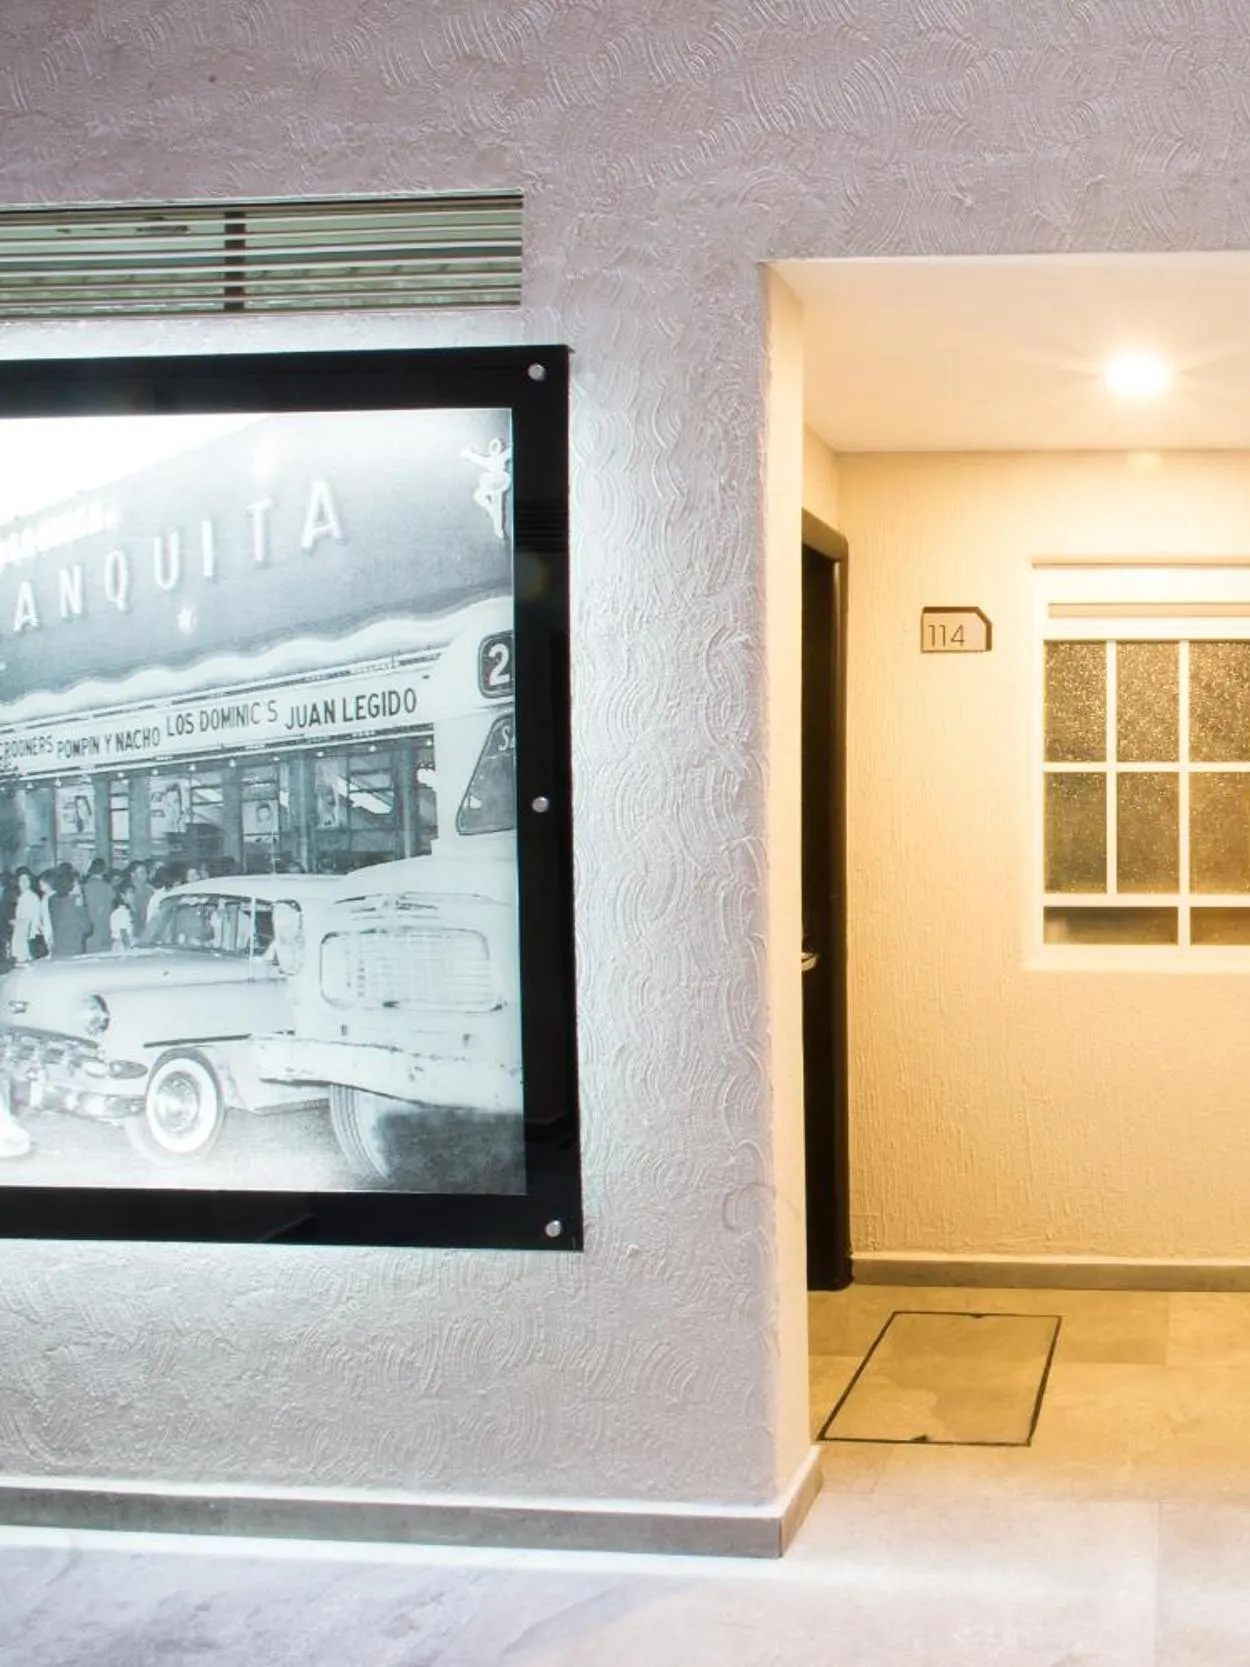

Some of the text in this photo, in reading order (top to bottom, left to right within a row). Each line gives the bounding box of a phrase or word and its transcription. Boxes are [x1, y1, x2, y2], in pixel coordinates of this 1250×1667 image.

[12, 480, 344, 632] ANQUITA
[488, 643, 510, 686] 2
[928, 624, 965, 648] 114
[0, 735, 53, 760] ROONERS
[104, 734, 113, 753] Y
[115, 726, 161, 751] NACHO
[166, 712, 195, 737] LOS
[286, 699, 336, 730] JUAN
[342, 687, 417, 723] LEGIDO
